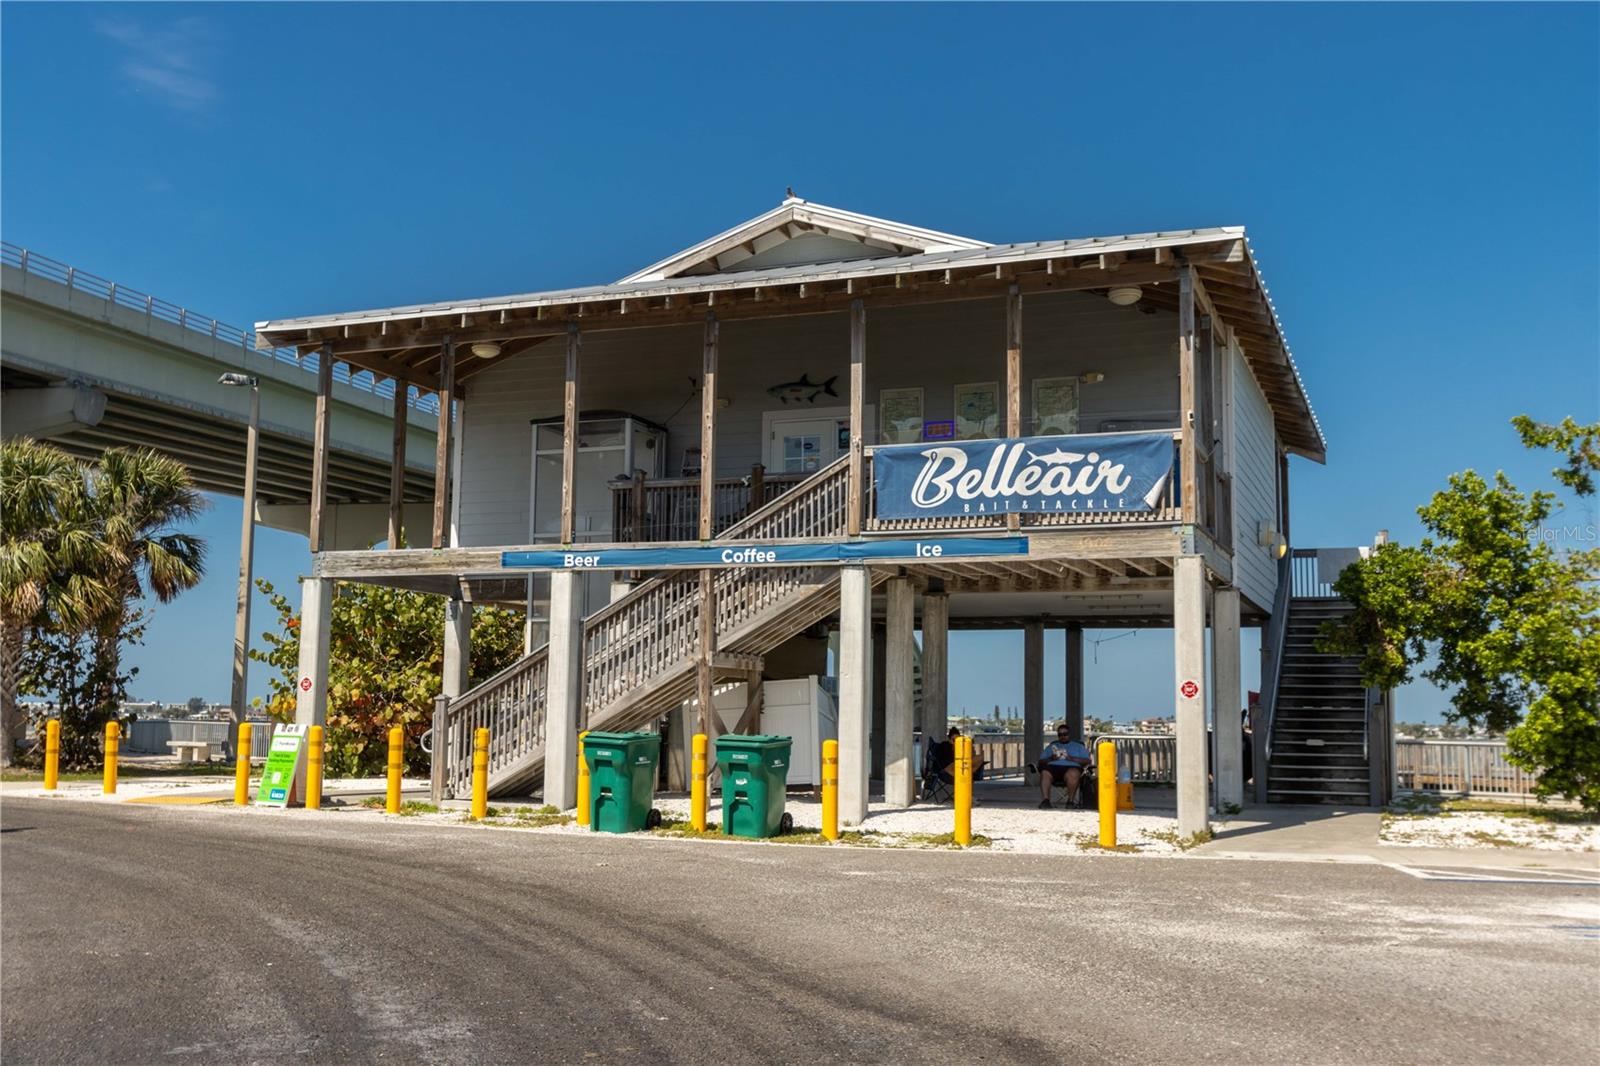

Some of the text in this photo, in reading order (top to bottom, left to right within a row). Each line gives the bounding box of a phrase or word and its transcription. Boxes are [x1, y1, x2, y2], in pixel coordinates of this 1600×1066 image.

[910, 442, 1132, 508] Belleair
[963, 497, 1125, 513] BAIT & TACKLE
[721, 548, 777, 564] Coffee
[915, 542, 943, 558] Ice
[563, 553, 601, 568] Beer
